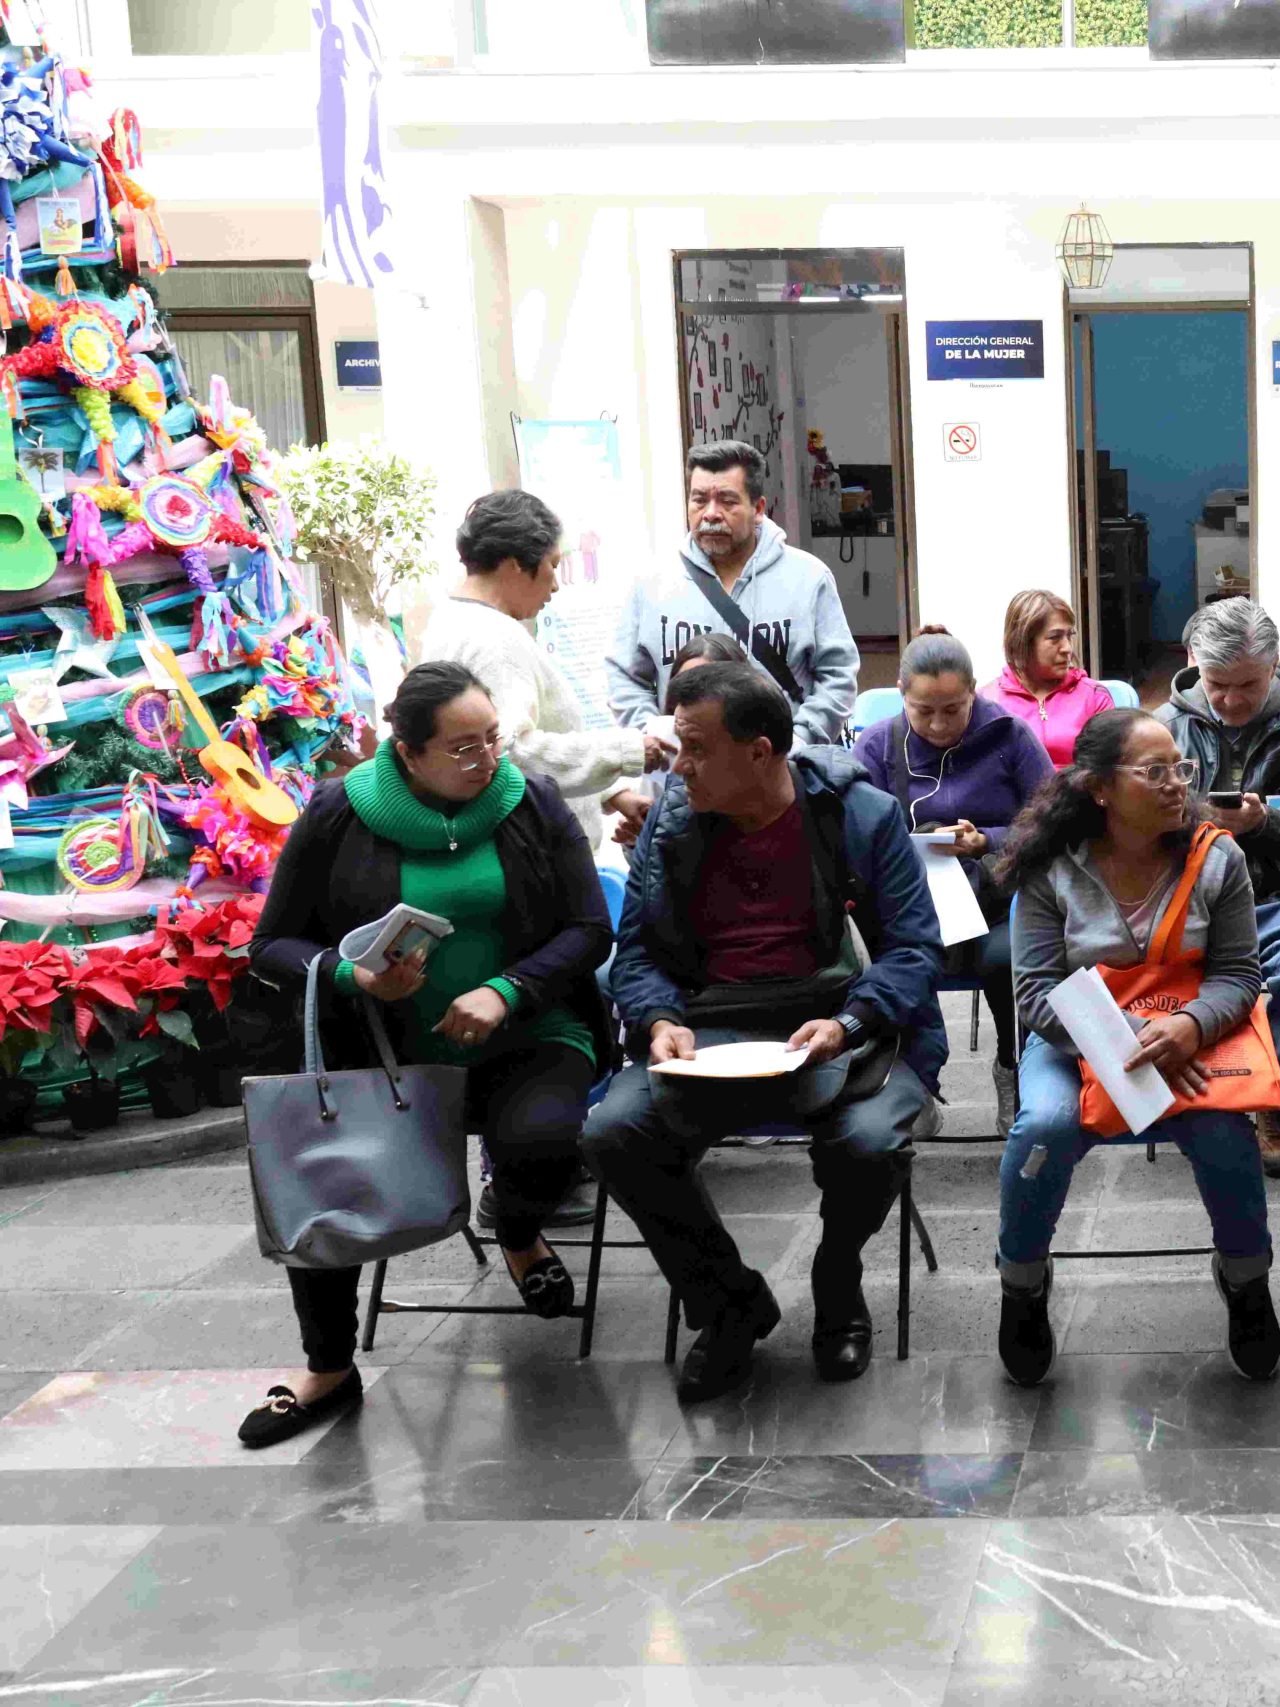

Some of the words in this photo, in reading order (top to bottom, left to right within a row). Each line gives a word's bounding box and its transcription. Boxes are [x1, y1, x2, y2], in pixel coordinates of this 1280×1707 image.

[936, 336, 988, 346] DIRECCIÓN
[990, 337, 1035, 345] GENERAL
[945, 350, 962, 359] DE
[965, 350, 981, 358] LA
[984, 350, 1025, 358] MUJER
[344, 359, 380, 367] ARCHIV
[660, 615, 792, 666] LOON
